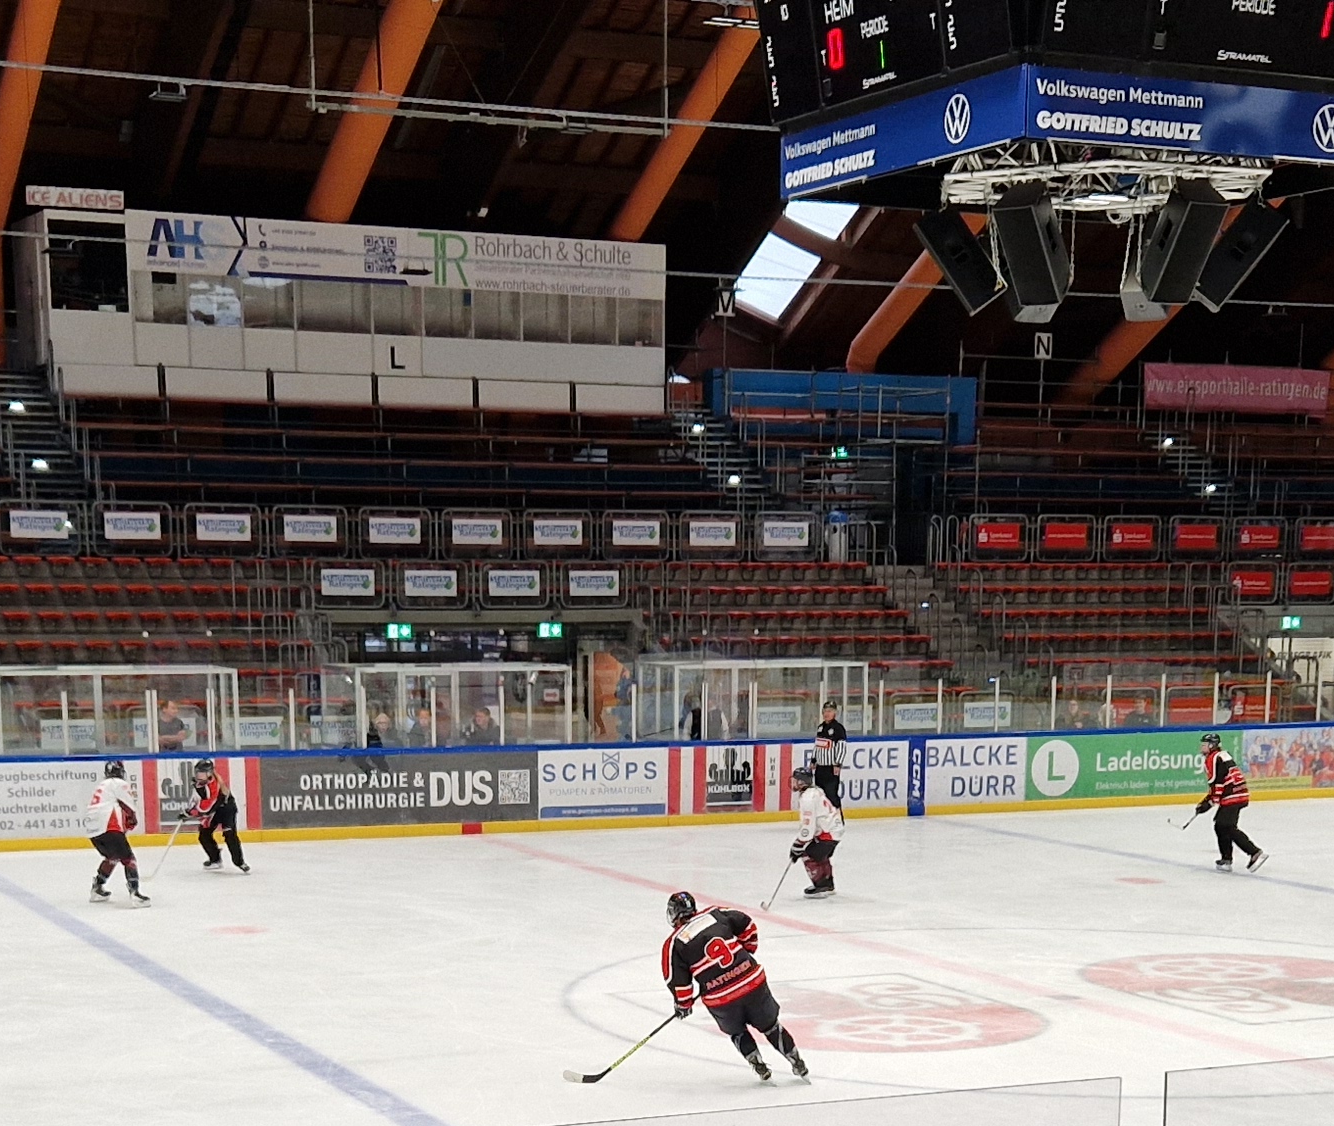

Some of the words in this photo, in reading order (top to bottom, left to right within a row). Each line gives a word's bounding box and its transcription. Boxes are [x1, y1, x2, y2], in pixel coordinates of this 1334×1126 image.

[824, 0, 854, 24] HEIM
[860, 15, 889, 39] PERIODE
[827, 27, 844, 70] 0
[1036, 78, 1126, 103] Volkswagen
[1129, 89, 1204, 109] Mettmann
[1036, 110, 1128, 135] GOTTFRIED
[1130, 118, 1203, 141] SCHULTZ
[785, 136, 831, 160] Volkswagen
[832, 124, 876, 148] Mettmann
[785, 159, 833, 189] GOTTFRIED
[834, 150, 876, 176] SCHULTZ
[55, 191, 122, 209] ALIENS
[474, 236, 552, 260] Rohrbach
[557, 241, 569, 261] &
[573, 243, 631, 266] Schulte
[391, 346, 405, 369] L
[1036, 336, 1051, 356] N
[1146, 375, 1327, 400] www.eissporthalle-ratingen.de
[927, 745, 1018, 768] BALCKE
[1047, 751, 1066, 781] L
[300, 769, 408, 791] ORTHOPÄDIE
[413, 771, 426, 788] &
[912, 748, 922, 799] CCM
[1132, 780, 1150, 789] laden
[7, 787, 56, 798] Schilder
[430, 769, 493, 808] DUS
[950, 775, 1016, 797] DÜRR
[269, 791, 425, 813] UNFALLCHIRURGIE
[25, 819, 47, 830] 441
[50, 818, 71, 829] 431
[704, 936, 735, 969] 9
